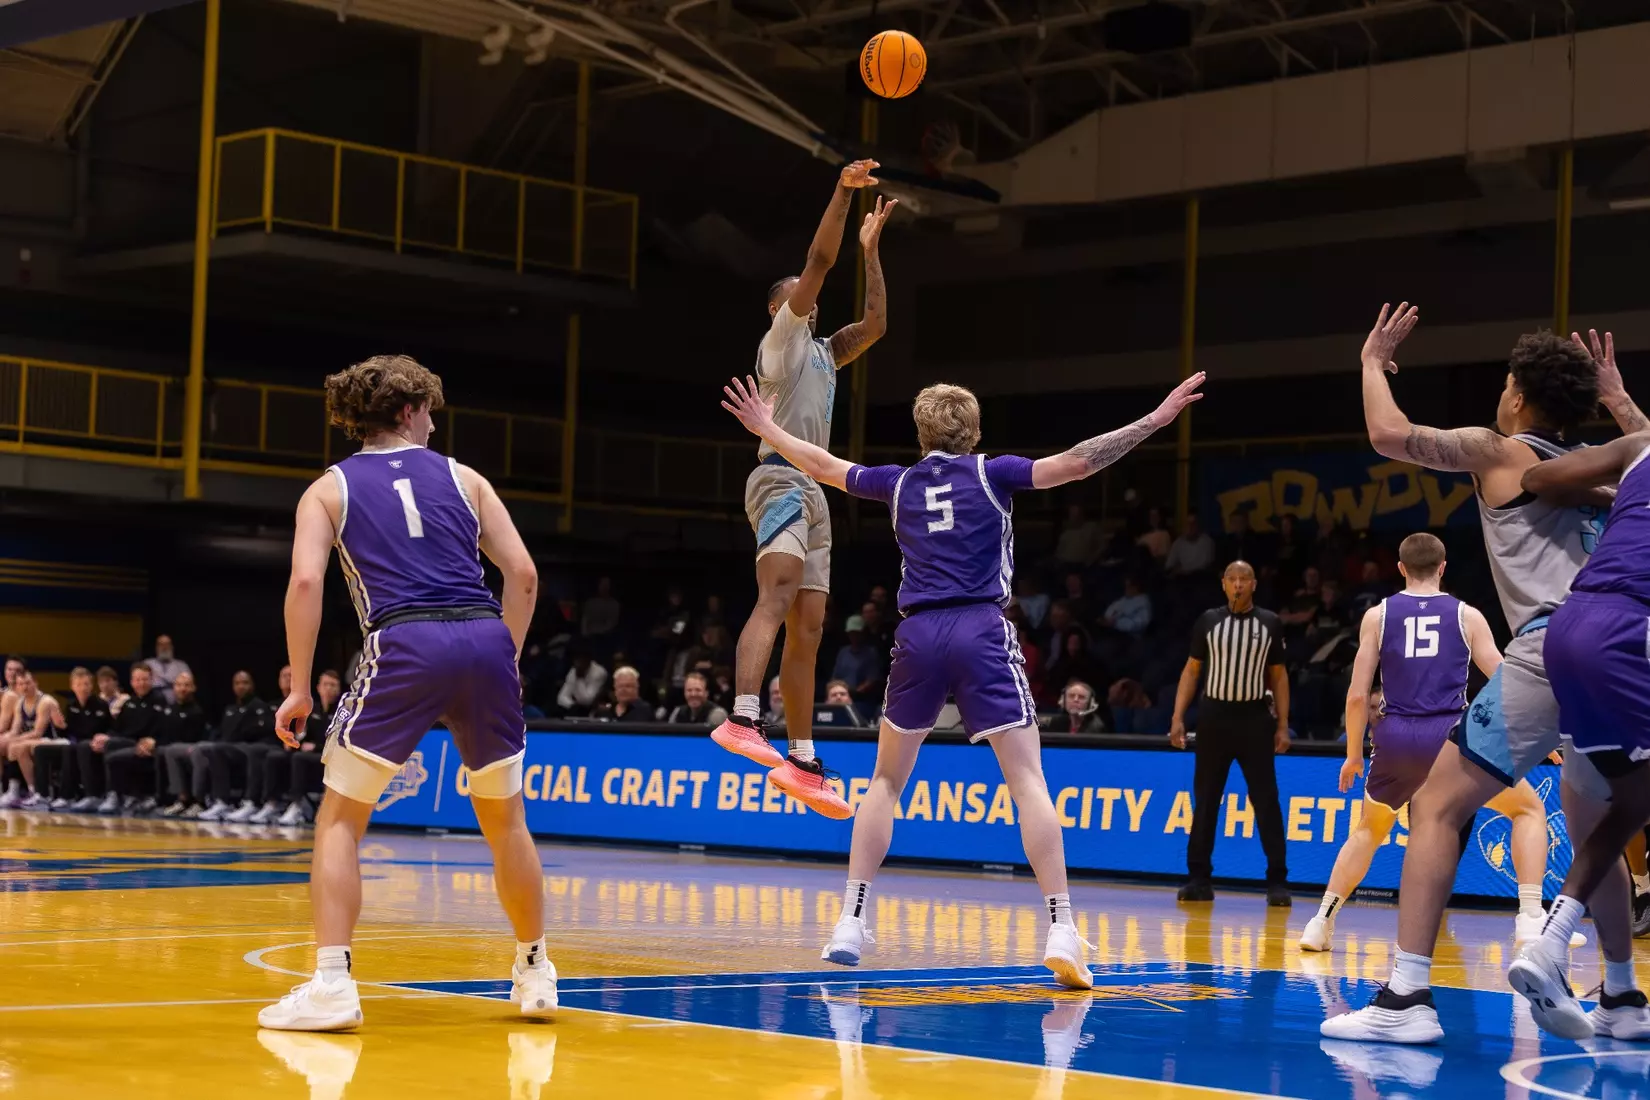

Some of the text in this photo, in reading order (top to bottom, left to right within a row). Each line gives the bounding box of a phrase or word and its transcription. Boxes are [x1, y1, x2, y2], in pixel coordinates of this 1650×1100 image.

[392, 478, 425, 538] 1
[925, 482, 955, 534] 5
[1217, 461, 1474, 533] ROWDY
[1403, 615, 1441, 659] 15
[455, 762, 592, 804] OCIAL
[601, 767, 711, 809] CRAFT
[893, 779, 1020, 826] ANSA
[1055, 786, 1153, 833] CITY
